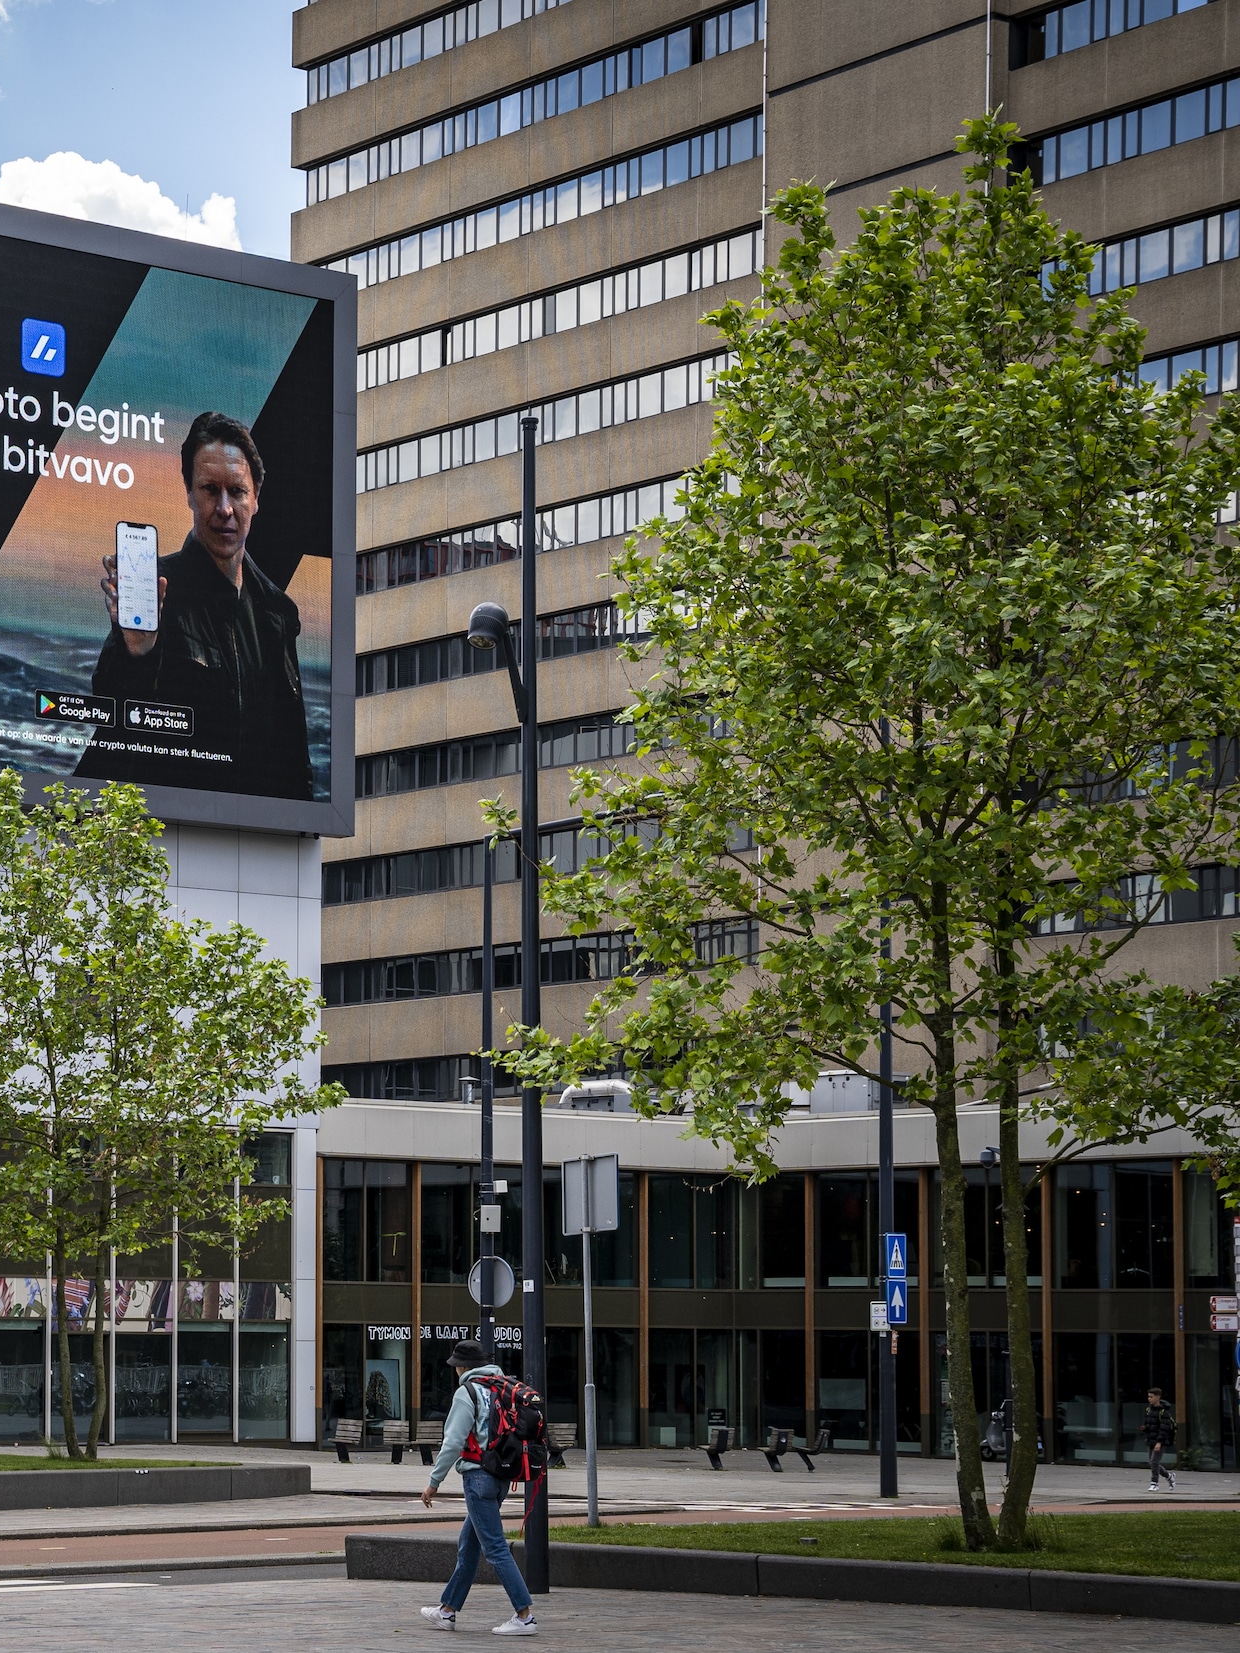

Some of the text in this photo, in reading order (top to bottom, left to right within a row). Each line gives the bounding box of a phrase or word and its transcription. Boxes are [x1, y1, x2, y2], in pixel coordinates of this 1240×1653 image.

[53, 391, 164, 444] begint
[3, 435, 134, 489] bitvavo
[59, 704, 110, 722] Google Play
[144, 714, 188, 730] App Store
[7, 730, 21, 740] op:
[22, 731, 34, 739] de
[36, 733, 67, 744] waarde
[69, 737, 84, 746] van
[85, 739, 97, 747] uw
[99, 740, 125, 751] crypto
[127, 743, 152, 753] valuta
[153, 745, 168, 755] kan
[170, 746, 190, 757] sterk
[191, 749, 233, 762] fluctueren.
[368, 1325, 411, 1340] TYMON
[435, 1325, 468, 1340] LAAT
[474, 1326, 522, 1342] SUDIO
